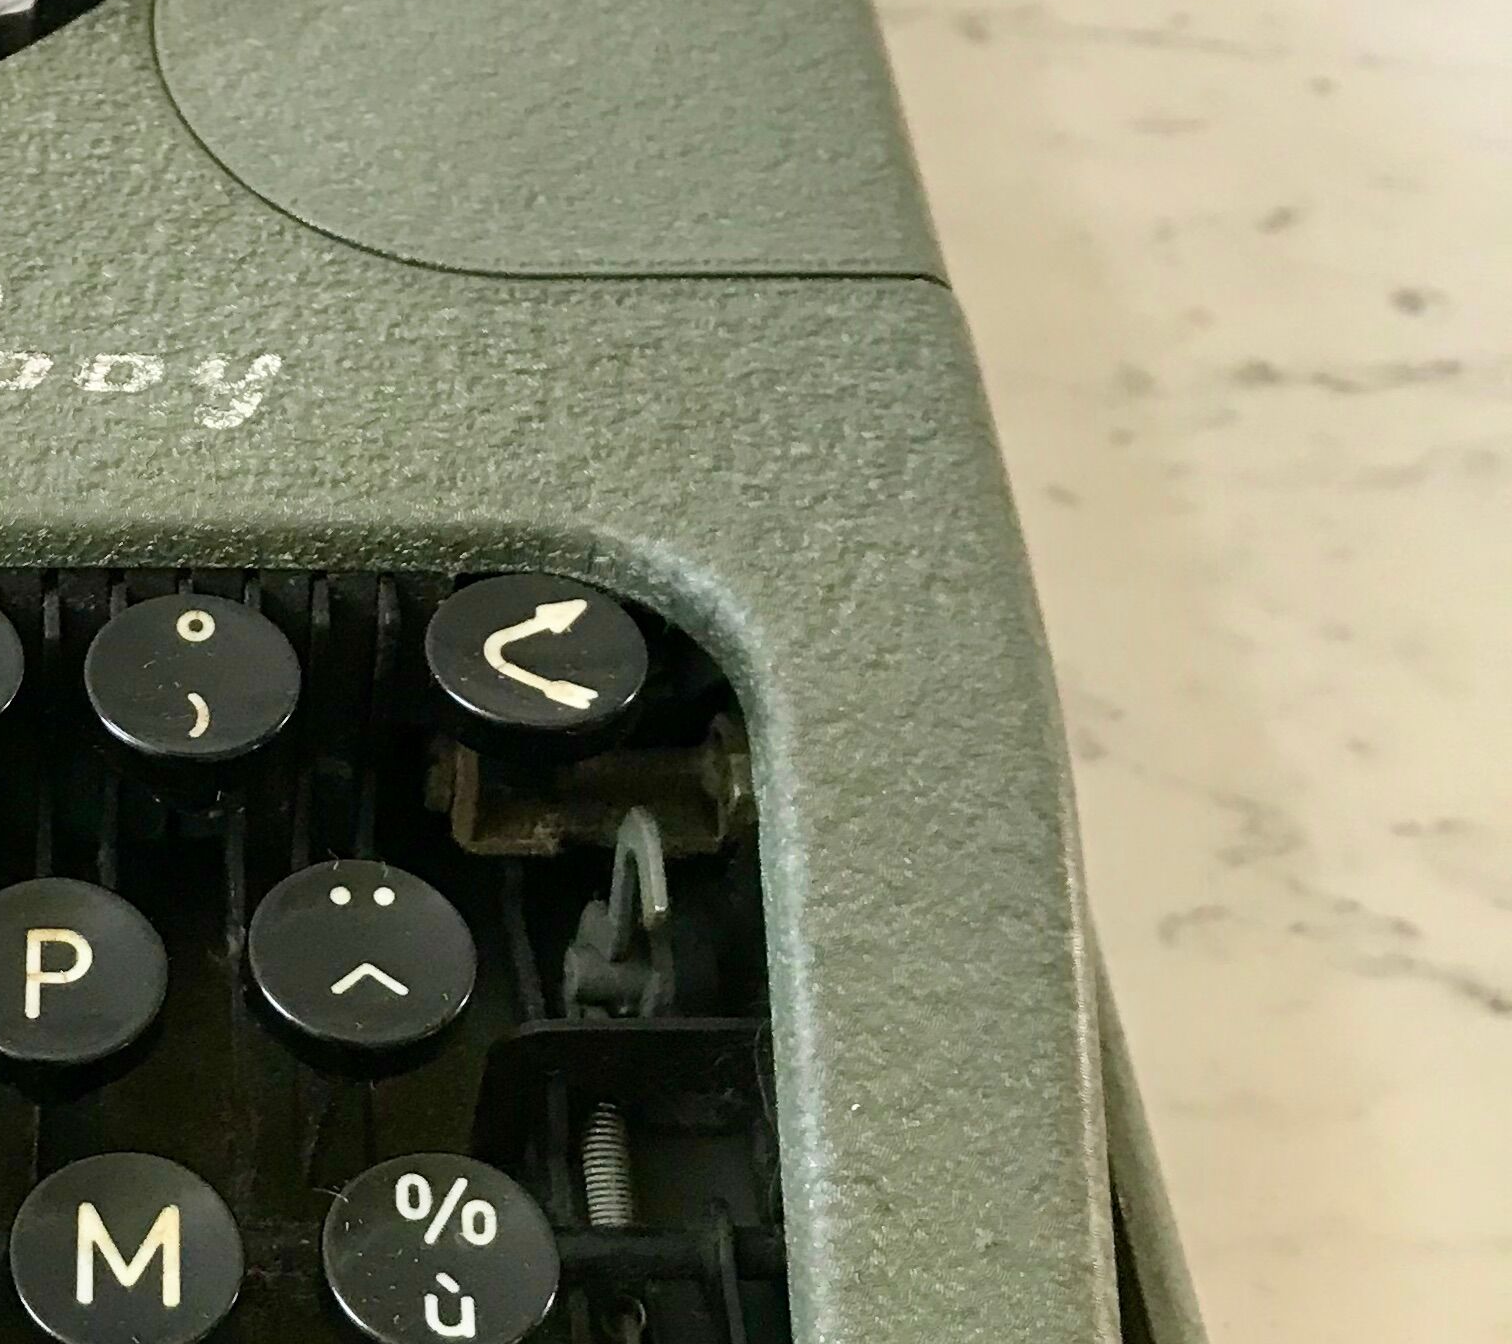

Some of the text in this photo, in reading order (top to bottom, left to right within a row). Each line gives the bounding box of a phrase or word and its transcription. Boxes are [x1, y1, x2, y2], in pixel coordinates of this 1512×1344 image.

[24, 928, 93, 1020] P
[395, 1173, 498, 1246] %
[76, 1202, 181, 1308] M
[423, 1272, 476, 1339] ù
